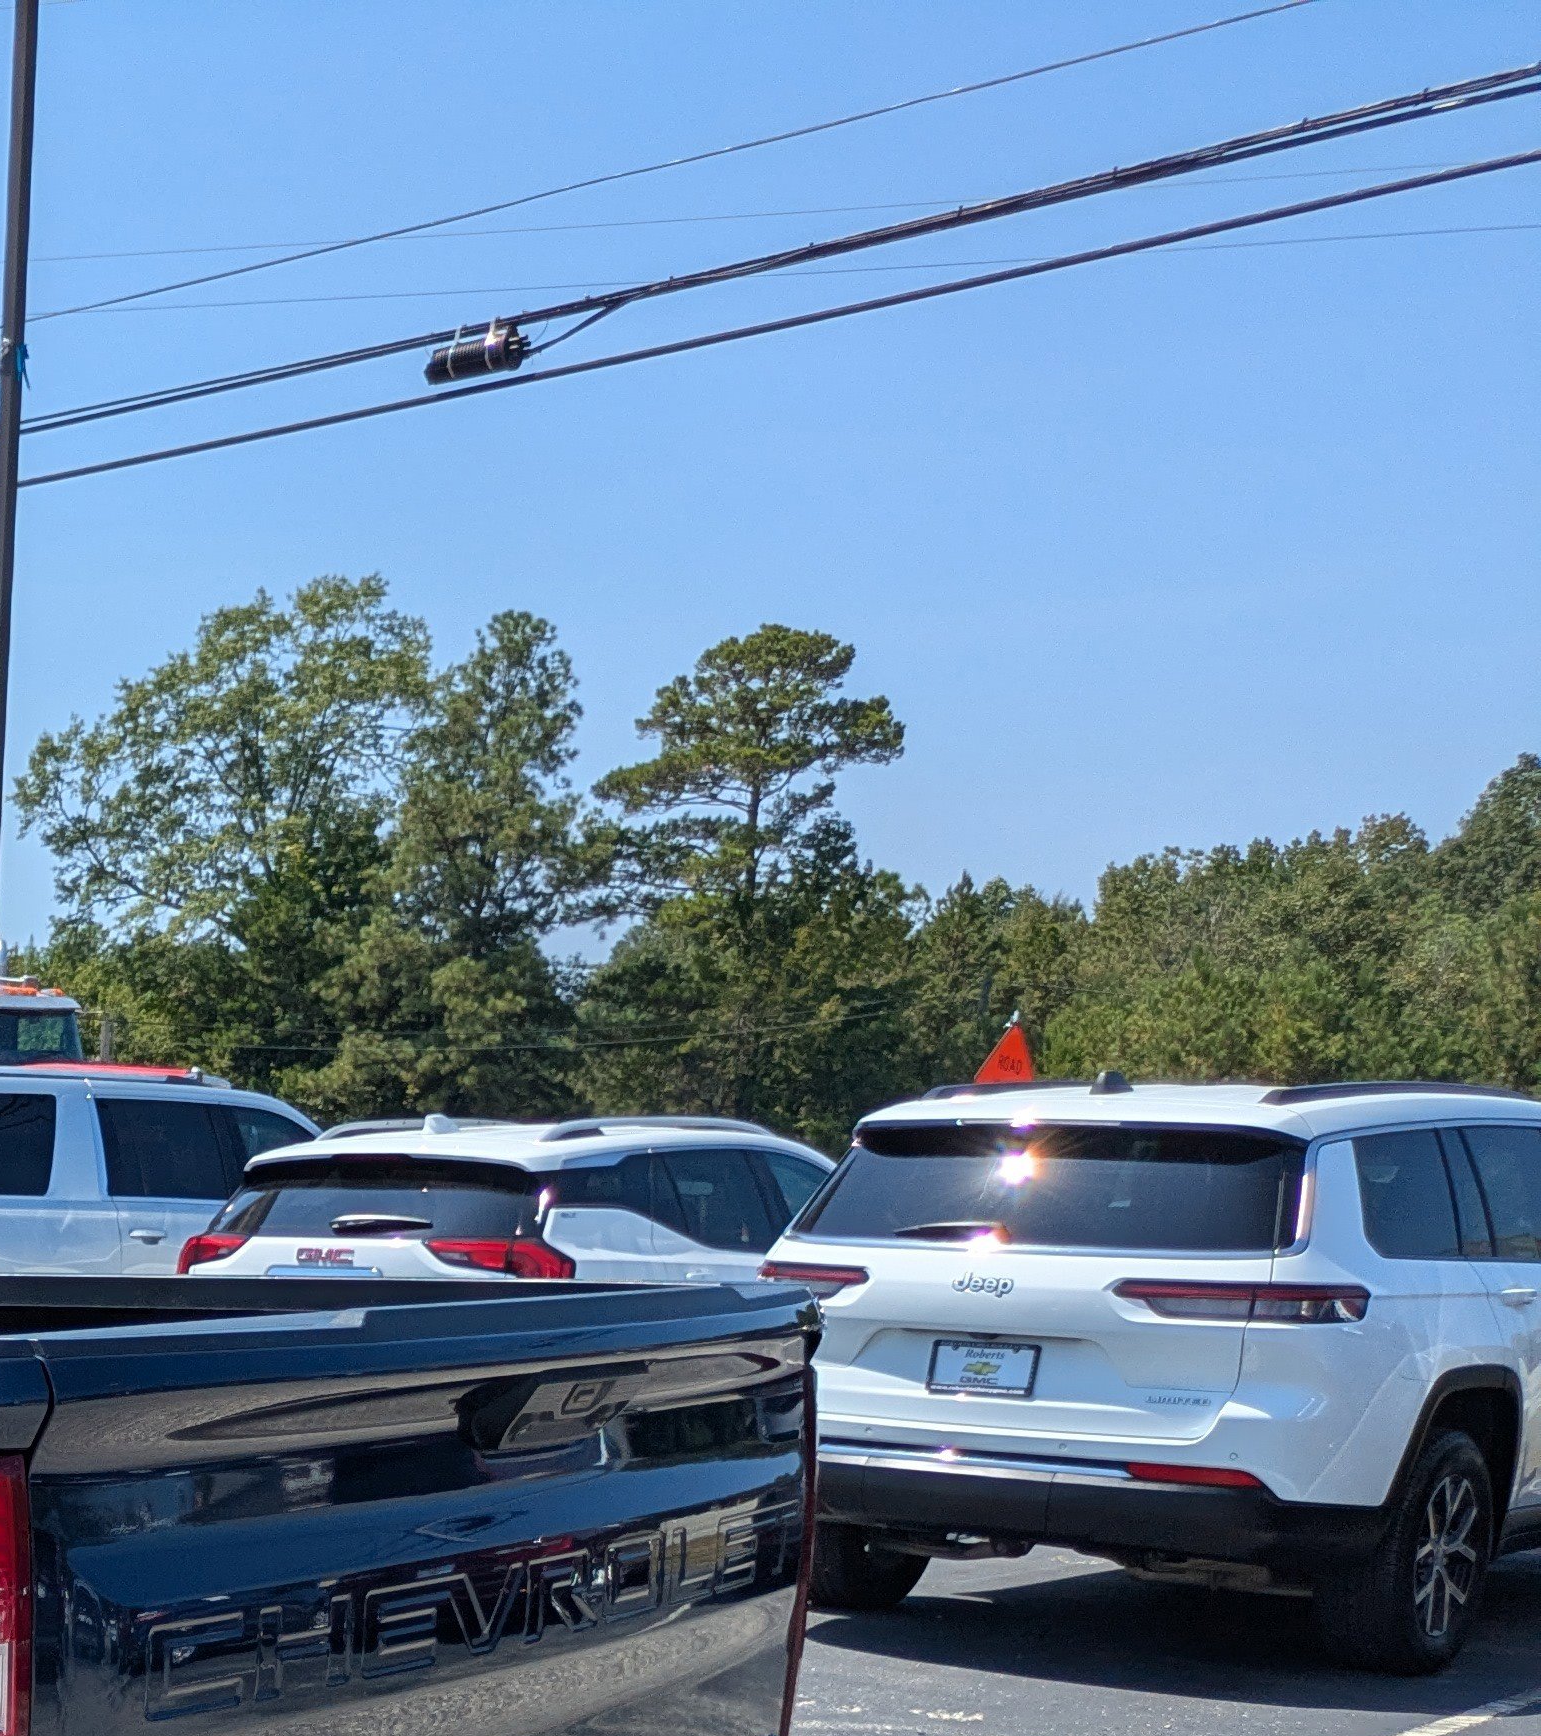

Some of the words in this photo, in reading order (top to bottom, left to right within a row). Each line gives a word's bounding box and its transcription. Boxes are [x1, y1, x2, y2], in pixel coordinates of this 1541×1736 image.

[296, 1248, 355, 1265] GMC
[952, 1272, 1014, 1298] Jeep
[964, 1349, 1006, 1360] Roberts
